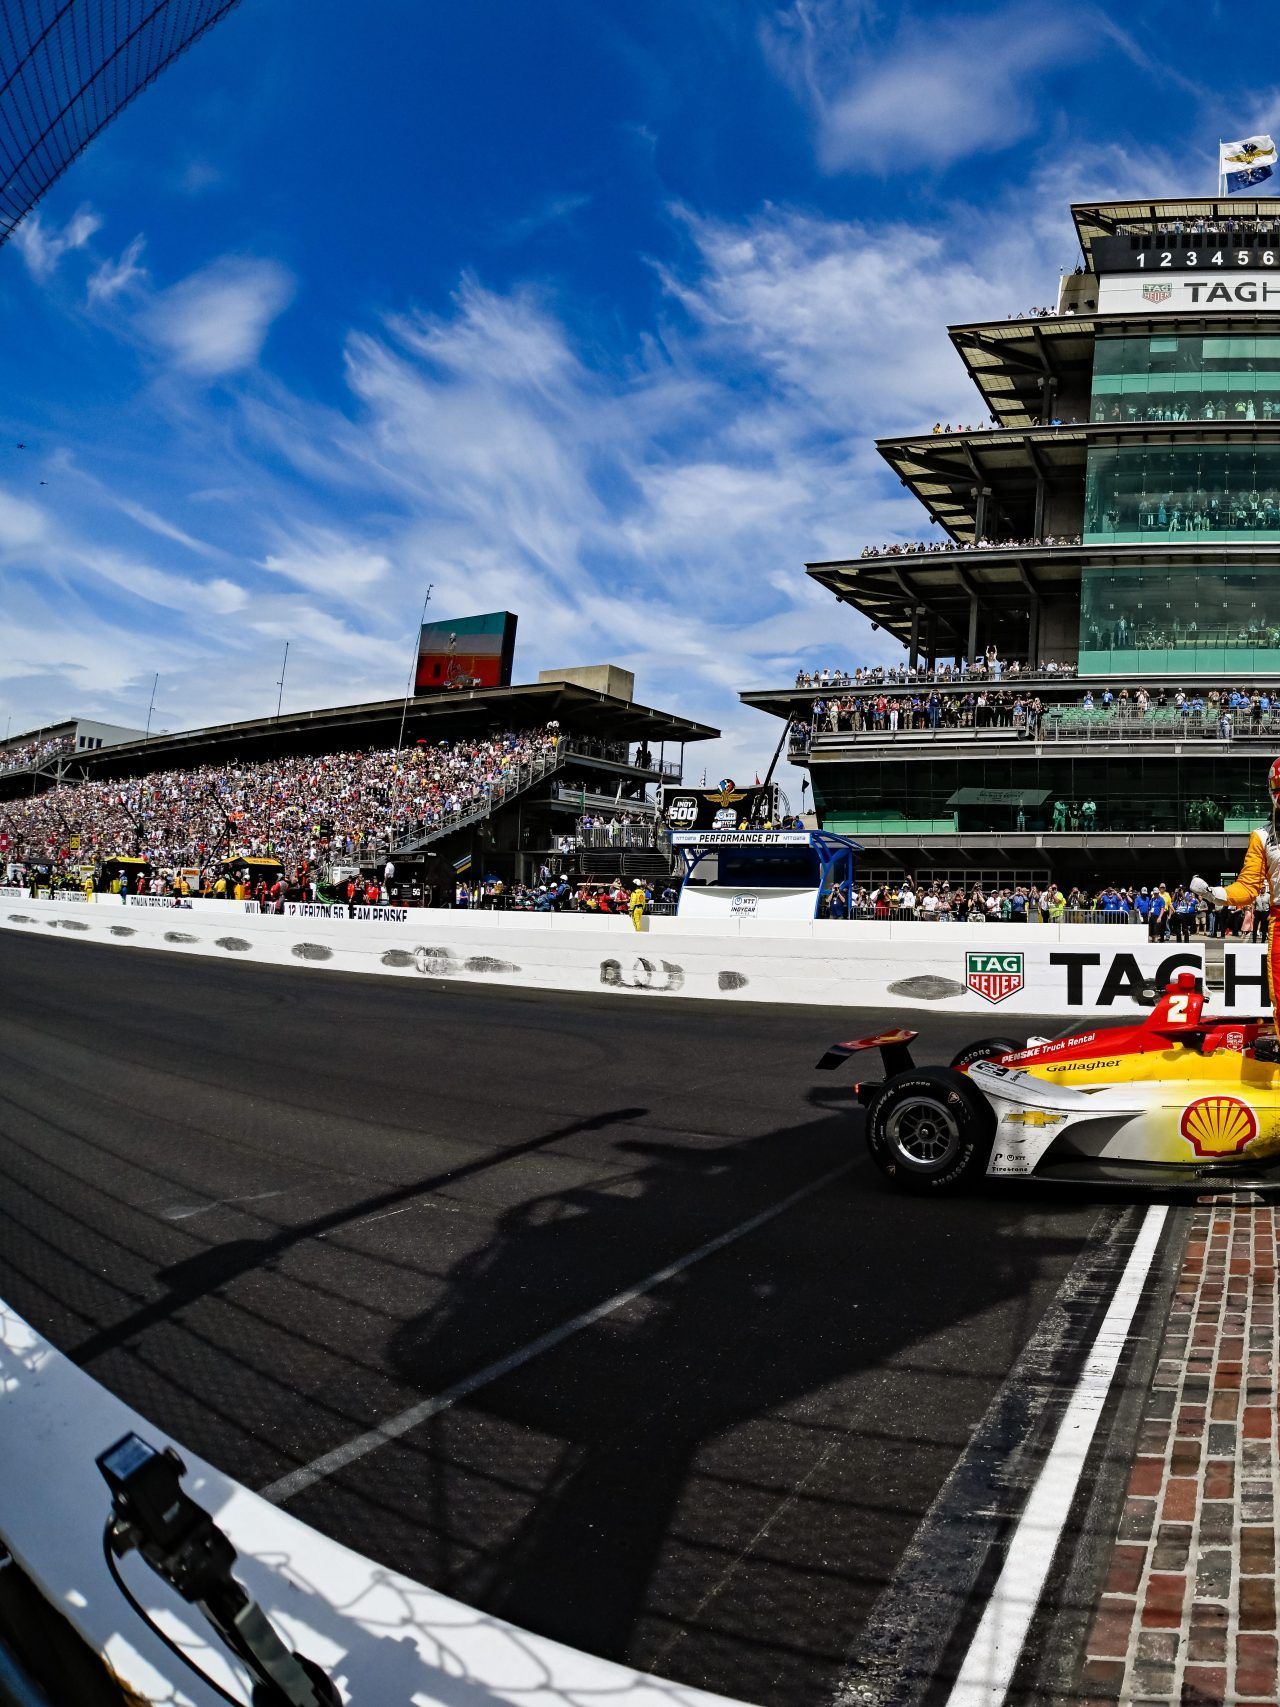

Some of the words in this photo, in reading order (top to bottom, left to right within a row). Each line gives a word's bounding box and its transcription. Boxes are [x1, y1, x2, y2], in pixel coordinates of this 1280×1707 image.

[1137, 253, 1145, 267] 1
[1160, 252, 1172, 267] 2
[1186, 251, 1197, 266] 3
[1212, 251, 1223, 265] 4
[1237, 251, 1249, 265] 5
[1263, 251, 1274, 265] 6
[669, 808, 697, 820] 500
[972, 957, 1018, 971] TAG
[970, 976, 1020, 998] HEUER
[1167, 996, 1189, 1022] 2
[1002, 1048, 1040, 1064] PENSKE
[1043, 1042, 1065, 1054] Truck
[1068, 1033, 1095, 1047] Rental
[1046, 1058, 1123, 1072] Gallagher
